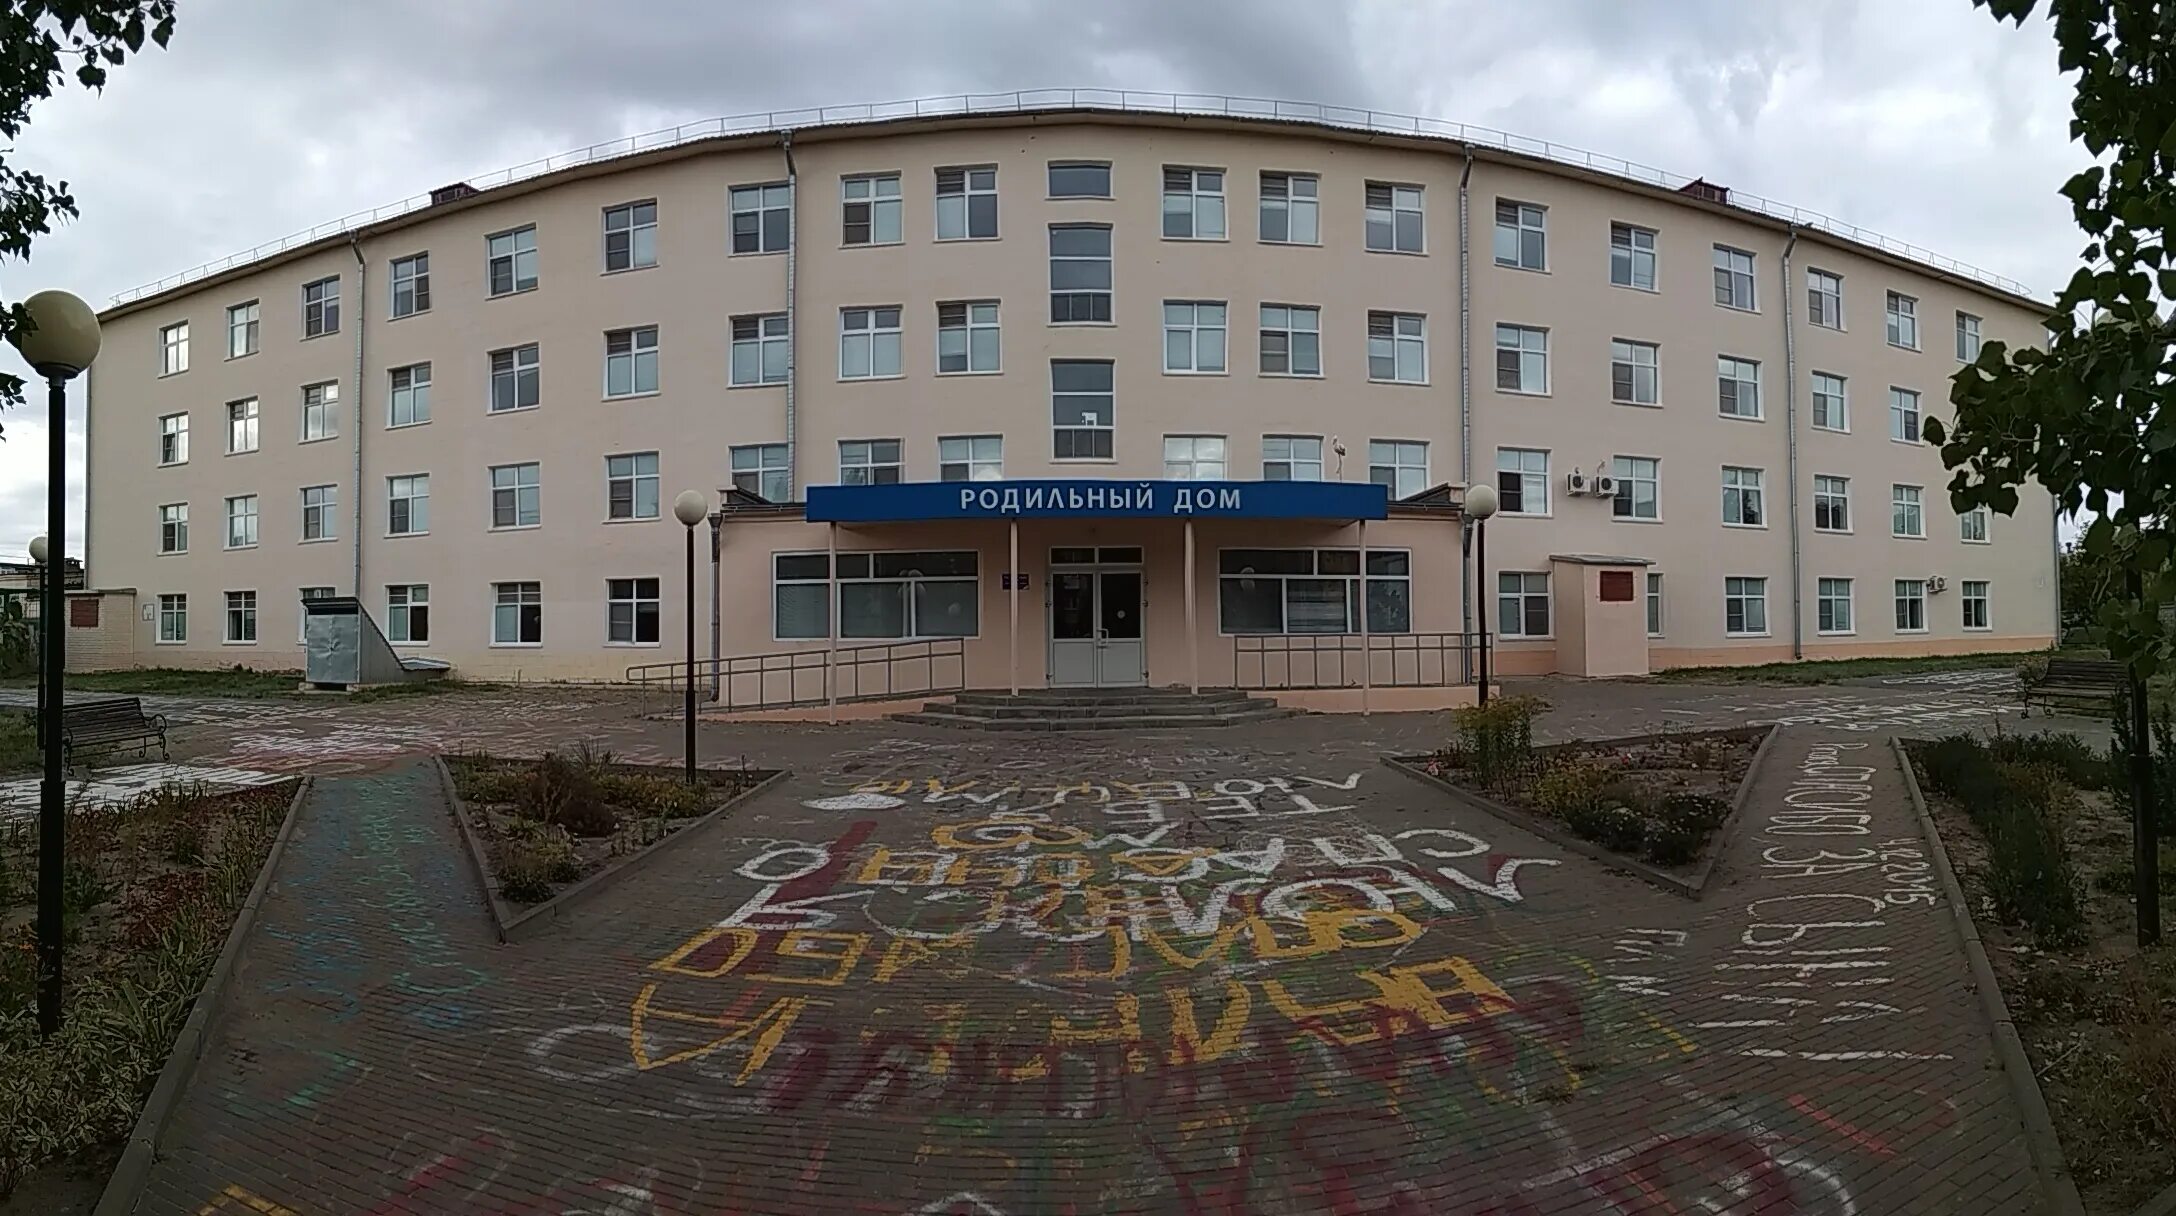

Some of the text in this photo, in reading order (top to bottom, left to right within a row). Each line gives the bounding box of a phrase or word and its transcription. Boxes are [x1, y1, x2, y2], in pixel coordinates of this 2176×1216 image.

[960, 483, 1241, 513] РОДИЛЬНЫЙ ДОМ
[1765, 766, 1877, 835] СПАСИБО
[1759, 847, 1876, 878] ЗА
